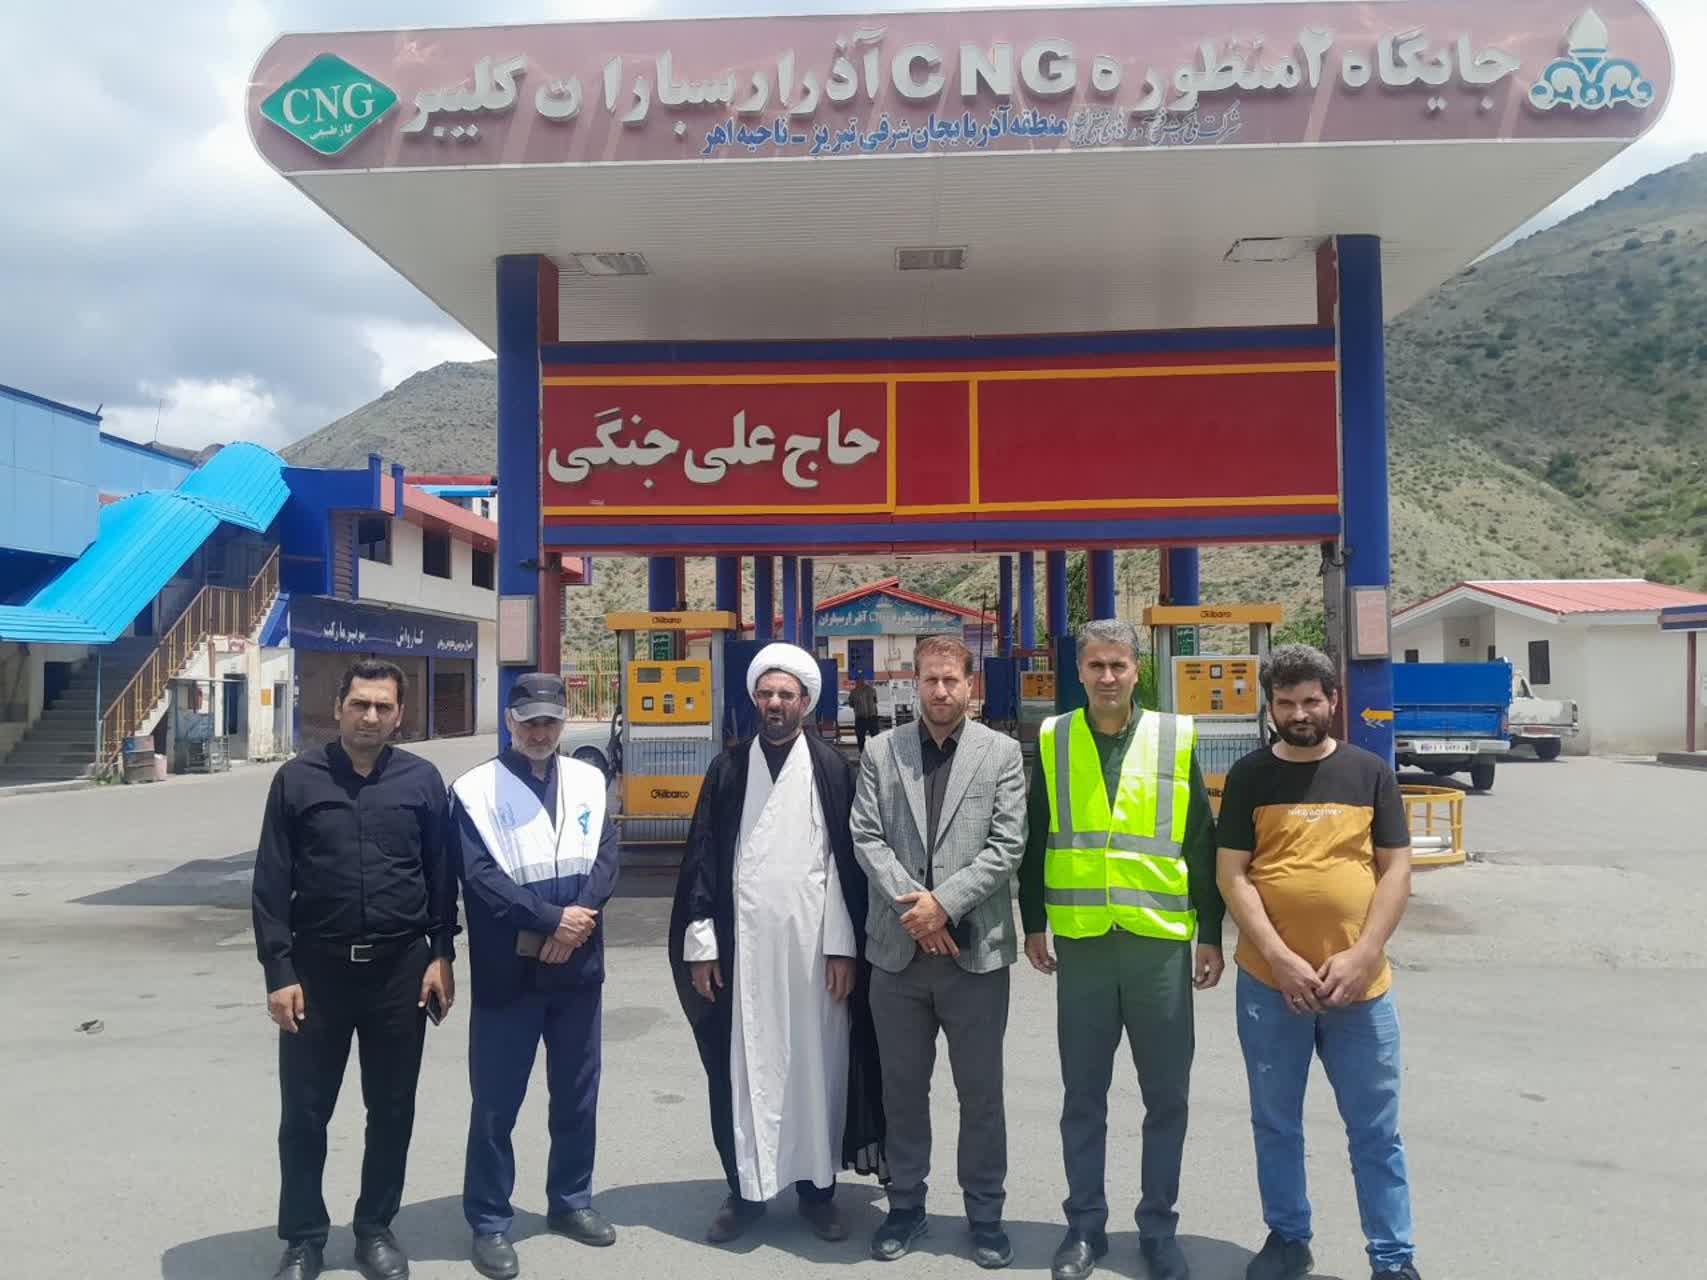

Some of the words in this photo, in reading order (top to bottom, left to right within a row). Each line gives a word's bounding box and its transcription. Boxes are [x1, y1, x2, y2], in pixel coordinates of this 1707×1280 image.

[398, 55, 528, 146] کلیبر
[534, 48, 796, 137] ارسباران
[788, 23, 888, 116] آذر
[891, 38, 1078, 99] CNG
[1092, 29, 1301, 112] منظوره
[1342, 25, 1521, 112] جایگاه
[282, 82, 375, 125] CNG
[701, 116, 735, 155] اهر
[737, 116, 788, 153] ناحیه
[809, 116, 858, 155] تبریز
[859, 112, 911, 152] شرقی
[911, 103, 1013, 150] آذربایجان
[1008, 107, 1071, 138] منطقه
[547, 407, 680, 489] جنگی
[684, 409, 776, 483] علی
[782, 408, 881, 488] حاج
